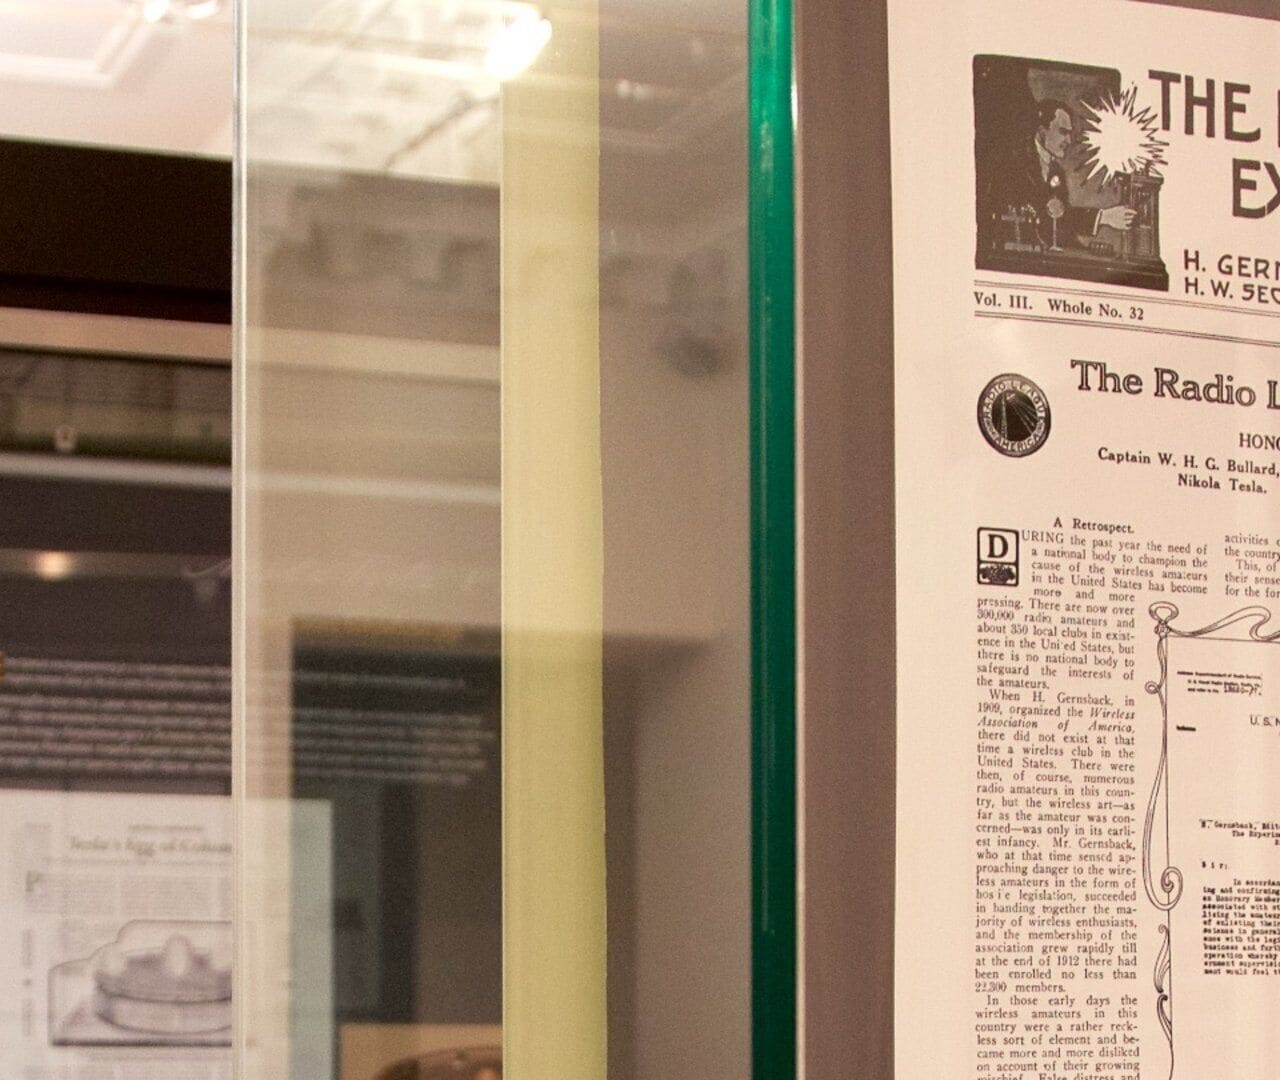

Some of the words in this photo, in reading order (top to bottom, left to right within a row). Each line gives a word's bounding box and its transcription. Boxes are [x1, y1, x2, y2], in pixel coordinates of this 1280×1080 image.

[1149, 70, 1261, 142] THE
[1184, 248, 1206, 272] H.
[1185, 276, 1204, 296] H.
[1211, 279, 1233, 299] W.
[974, 291, 1001, 307] Vol.
[1010, 295, 1032, 310] III.
[1048, 298, 1092, 316] Whole
[1099, 303, 1122, 318] No.
[1130, 306, 1143, 321] 32
[1071, 359, 1143, 396] The
[1154, 366, 1256, 407] Radio
[1098, 446, 1150, 465] Captain
[1158, 452, 1176, 467] W.
[1184, 455, 1198, 468] H.
[1205, 456, 1219, 471] G.
[1228, 459, 1280, 479] Bullard,
[1178, 473, 1220, 490] Nikola
[1229, 478, 1267, 494] Tesla.
[1054, 516, 1062, 528] A
